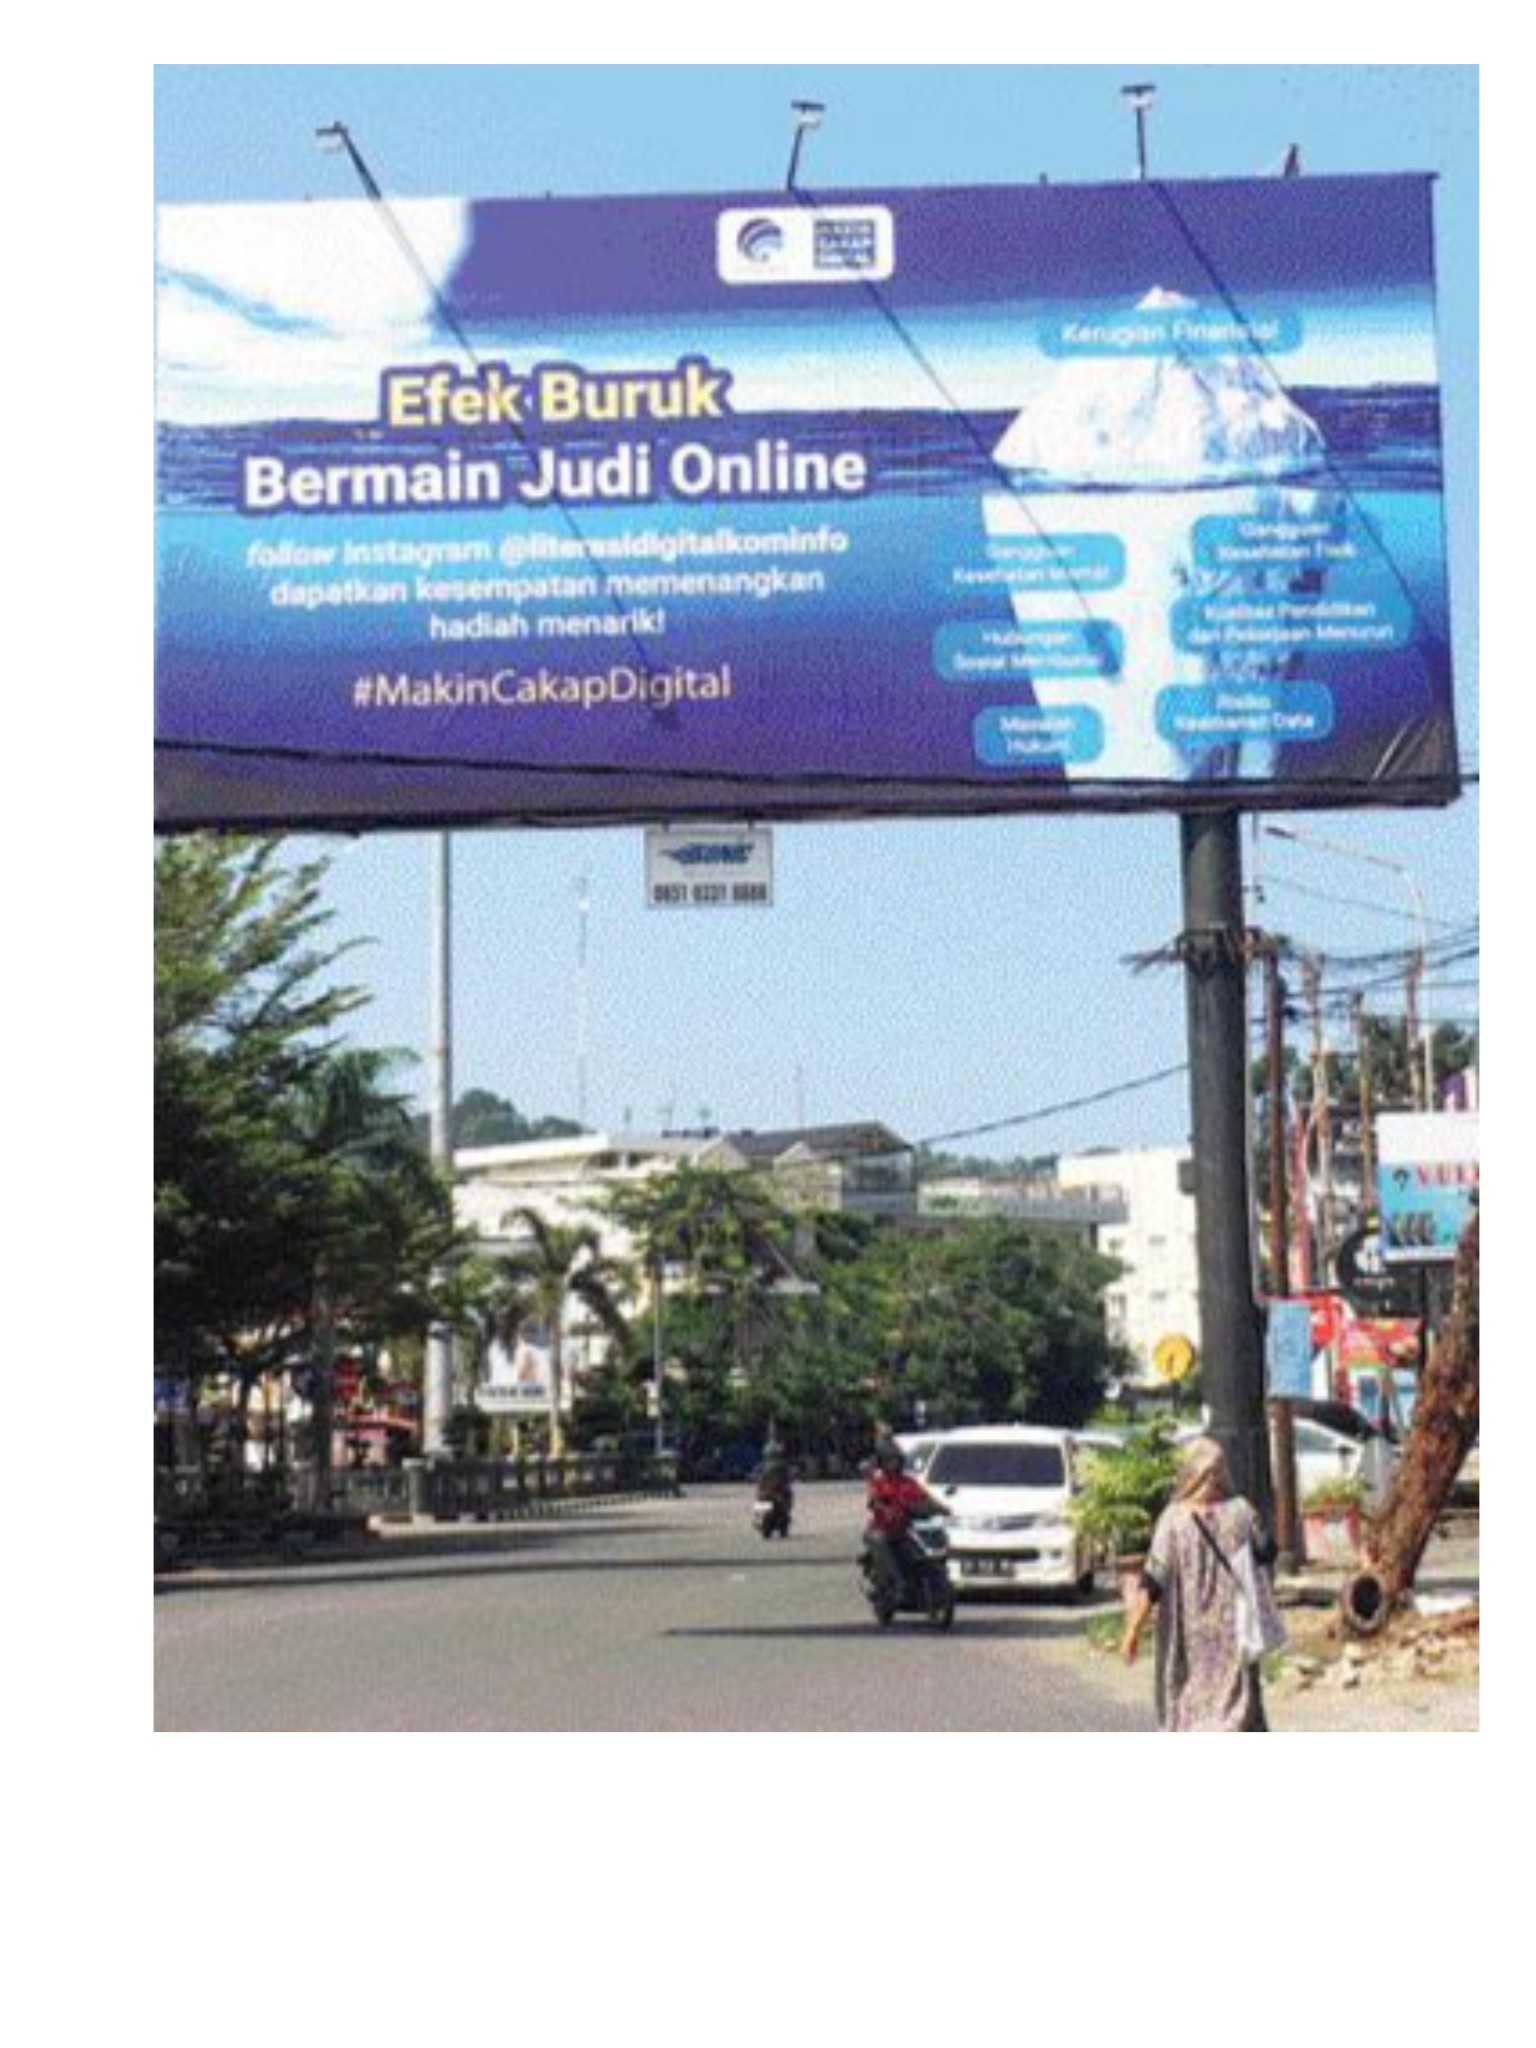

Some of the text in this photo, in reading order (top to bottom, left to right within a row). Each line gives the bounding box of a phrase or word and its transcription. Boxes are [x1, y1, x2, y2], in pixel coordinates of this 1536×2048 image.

[389, 366, 722, 426] Efek Buruk
[244, 439, 868, 506] Bermain Judi Online
[247, 540, 335, 567] follow
[270, 566, 824, 608] dapatkan kesempatan memenangkan
[430, 606, 666, 640] hadiah menarik!
[353, 664, 731, 710] #MakinCakapDigital
